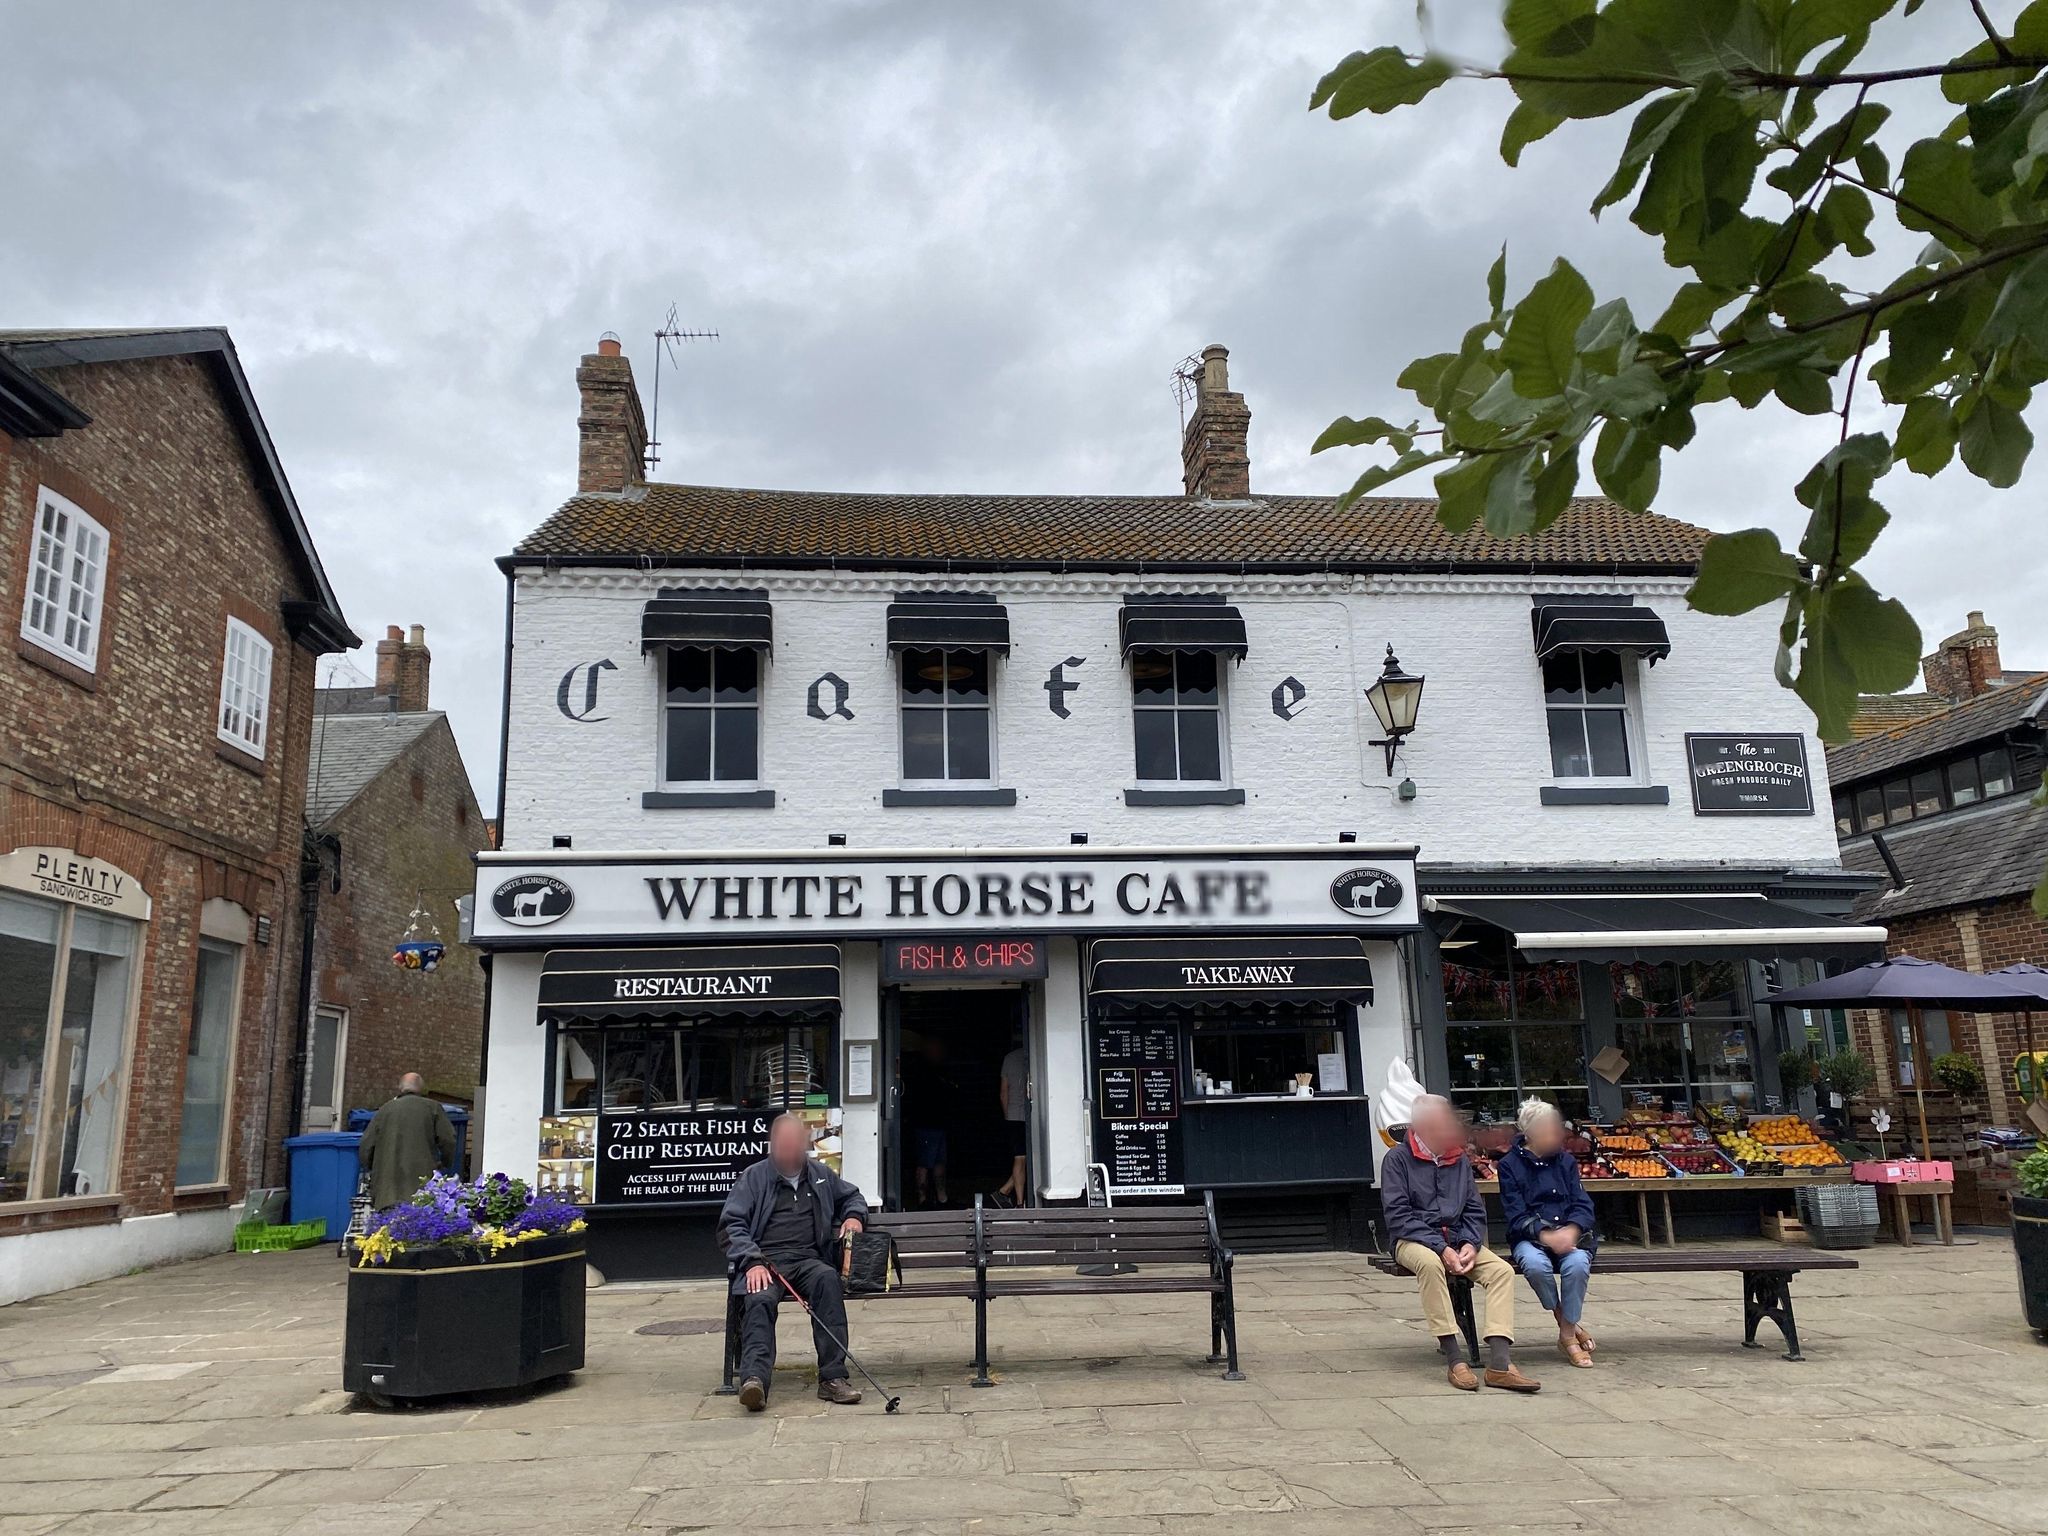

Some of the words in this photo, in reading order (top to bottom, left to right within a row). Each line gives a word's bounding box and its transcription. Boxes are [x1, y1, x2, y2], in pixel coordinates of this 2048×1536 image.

[1735, 743, 1757, 756] The
[1696, 760, 1803, 778] GREENGROCER
[1737, 776, 1768, 784] PRODUCE
[1771, 777, 1792, 786] DAILY
[36, 853, 122, 894] PLENTY
[1335, 872, 1356, 888] WHITE
[1357, 870, 1380, 878] HORSE
[40, 879, 90, 903] SANDWICH
[92, 893, 114, 907] SHOP
[496, 880, 521, 897] WHITE
[522, 876, 549, 885] HORSE
[643, 875, 863, 920] WHITE
[885, 871, 1094, 918] HORSE
[1116, 870, 1272, 917] CAFE
[900, 945, 945, 970] FISH
[952, 945, 967, 969] &
[975, 942, 1034, 967] CHIPS
[1181, 966, 1296, 984] TAKEAWAY
[614, 976, 772, 998] RESTAURANT
[612, 1122, 632, 1138] 72
[752, 1118, 768, 1134] &
[1111, 1122, 1137, 1131] Bikers
[1139, 1121, 1169, 1132] Special
[627, 1174, 664, 1184] ACCESS
[666, 1174, 686, 1182] LIFT
[688, 1171, 736, 1182] AVAILABLE
[622, 1187, 642, 1195] THE
[645, 1186, 670, 1194] REAR
[672, 1185, 685, 1194] OF
[687, 1184, 706, 1193] THE
[710, 1184, 734, 1192] BUIL
